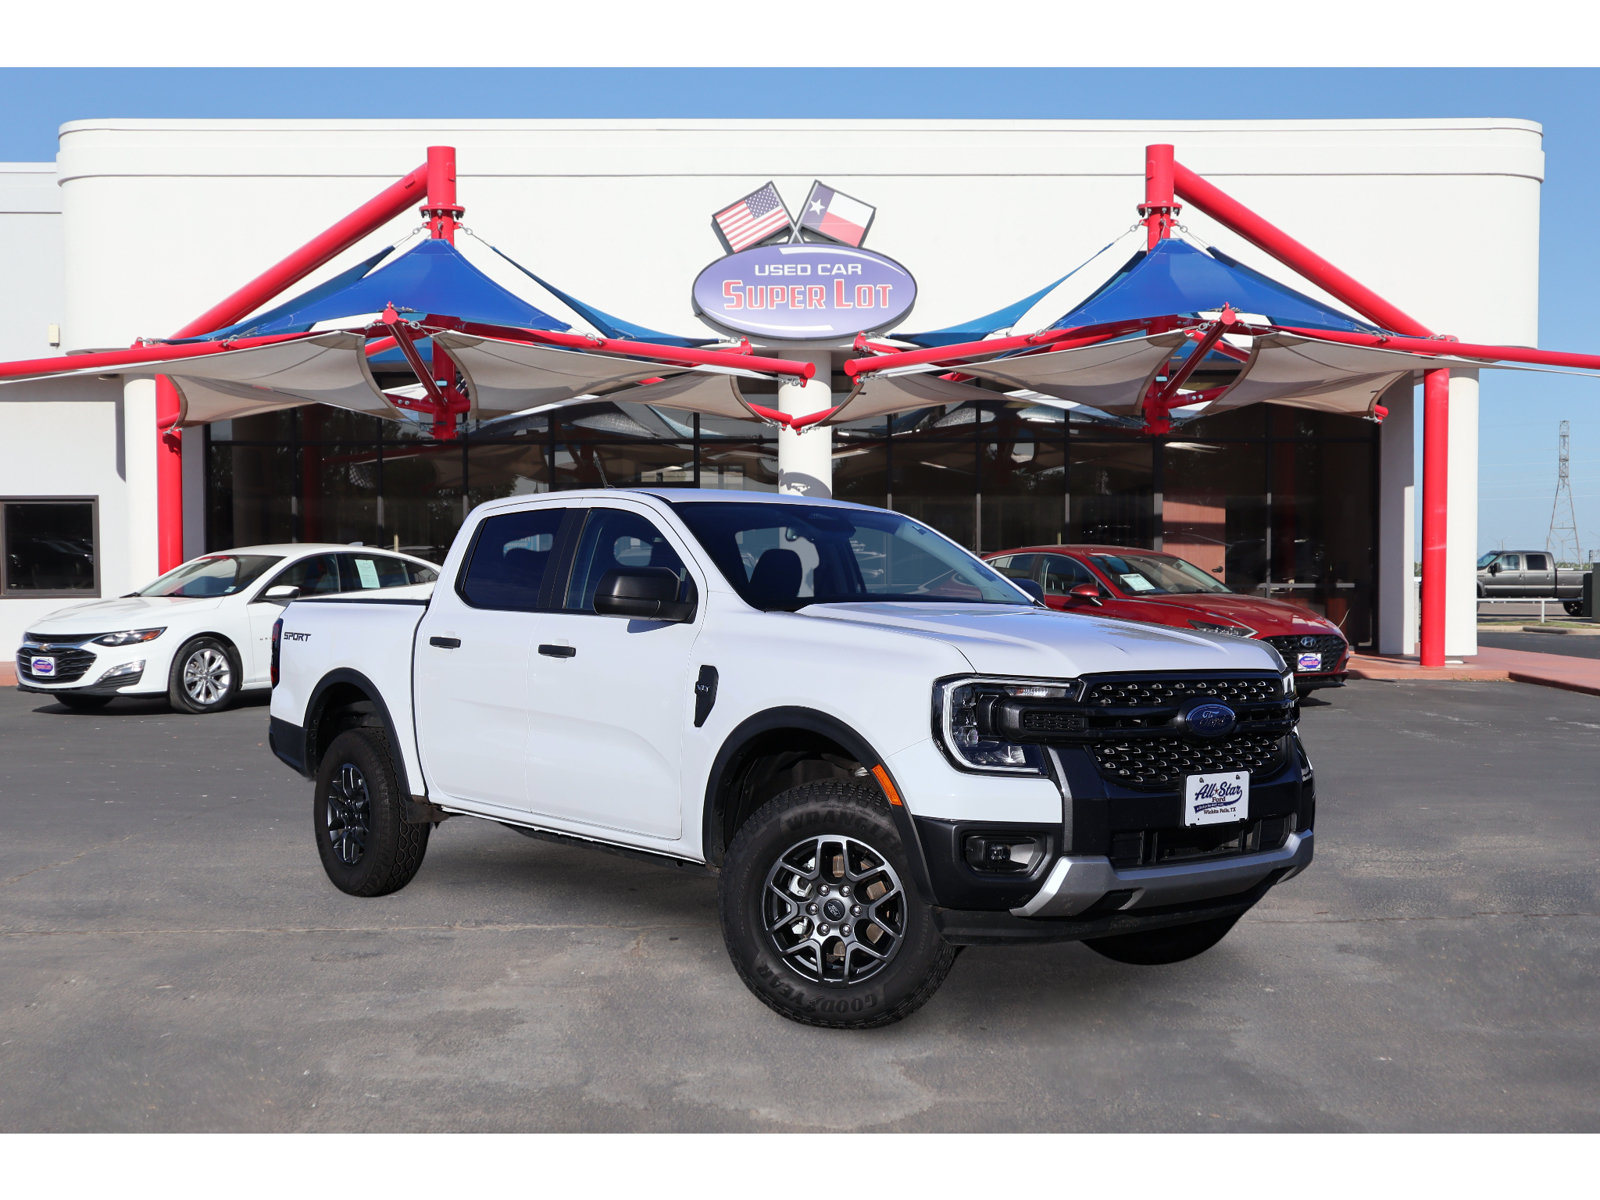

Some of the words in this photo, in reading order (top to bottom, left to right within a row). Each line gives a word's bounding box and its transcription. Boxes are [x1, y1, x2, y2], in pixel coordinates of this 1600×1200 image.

[754, 263, 811, 276] USED
[817, 263, 862, 276] CAR
[284, 631, 312, 642] SPORT
[1195, 783, 1216, 800] All
[1219, 781, 1242, 797] Star
